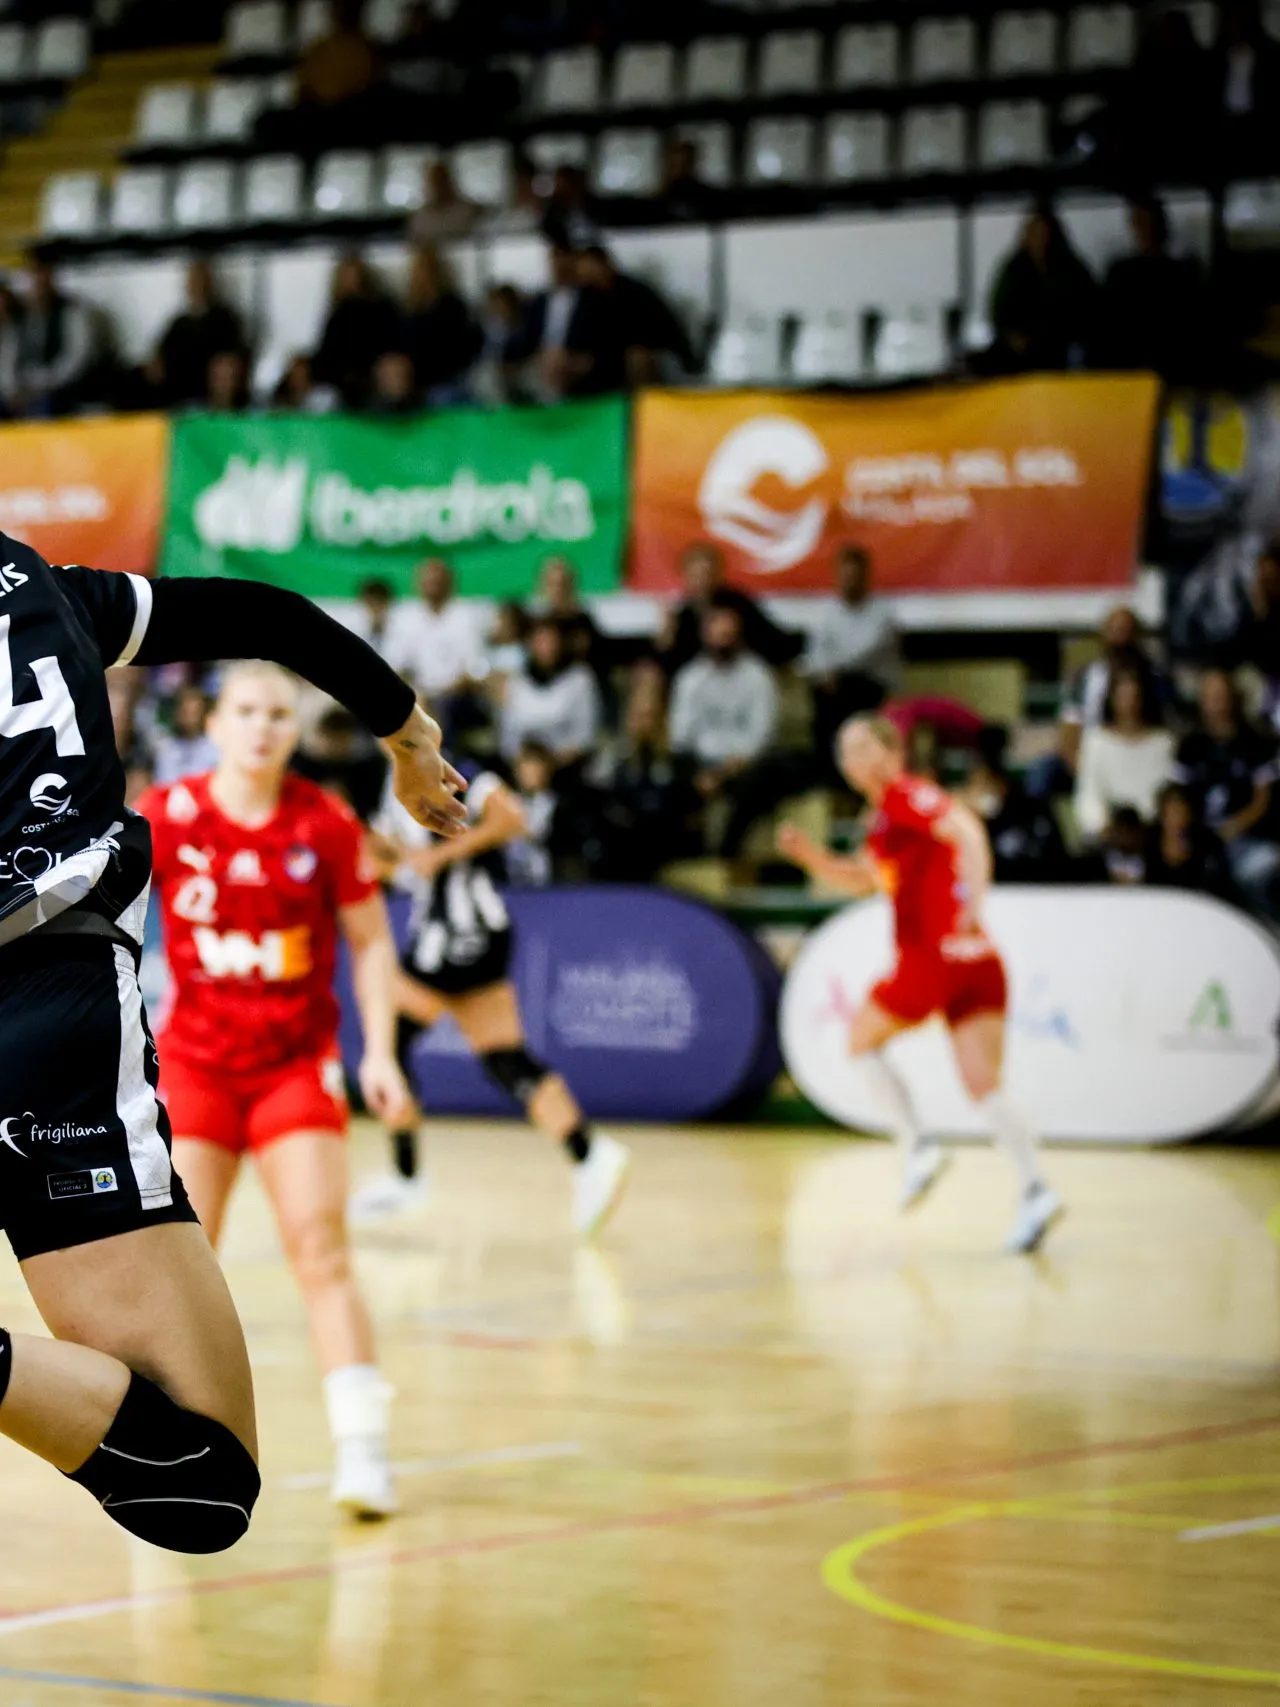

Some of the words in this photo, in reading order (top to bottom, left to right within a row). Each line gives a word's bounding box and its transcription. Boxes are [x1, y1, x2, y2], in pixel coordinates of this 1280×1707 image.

[314, 467, 591, 543] Iberdrola
[21, 822, 51, 834] COST
[31, 1122, 108, 1144] frigiliana
